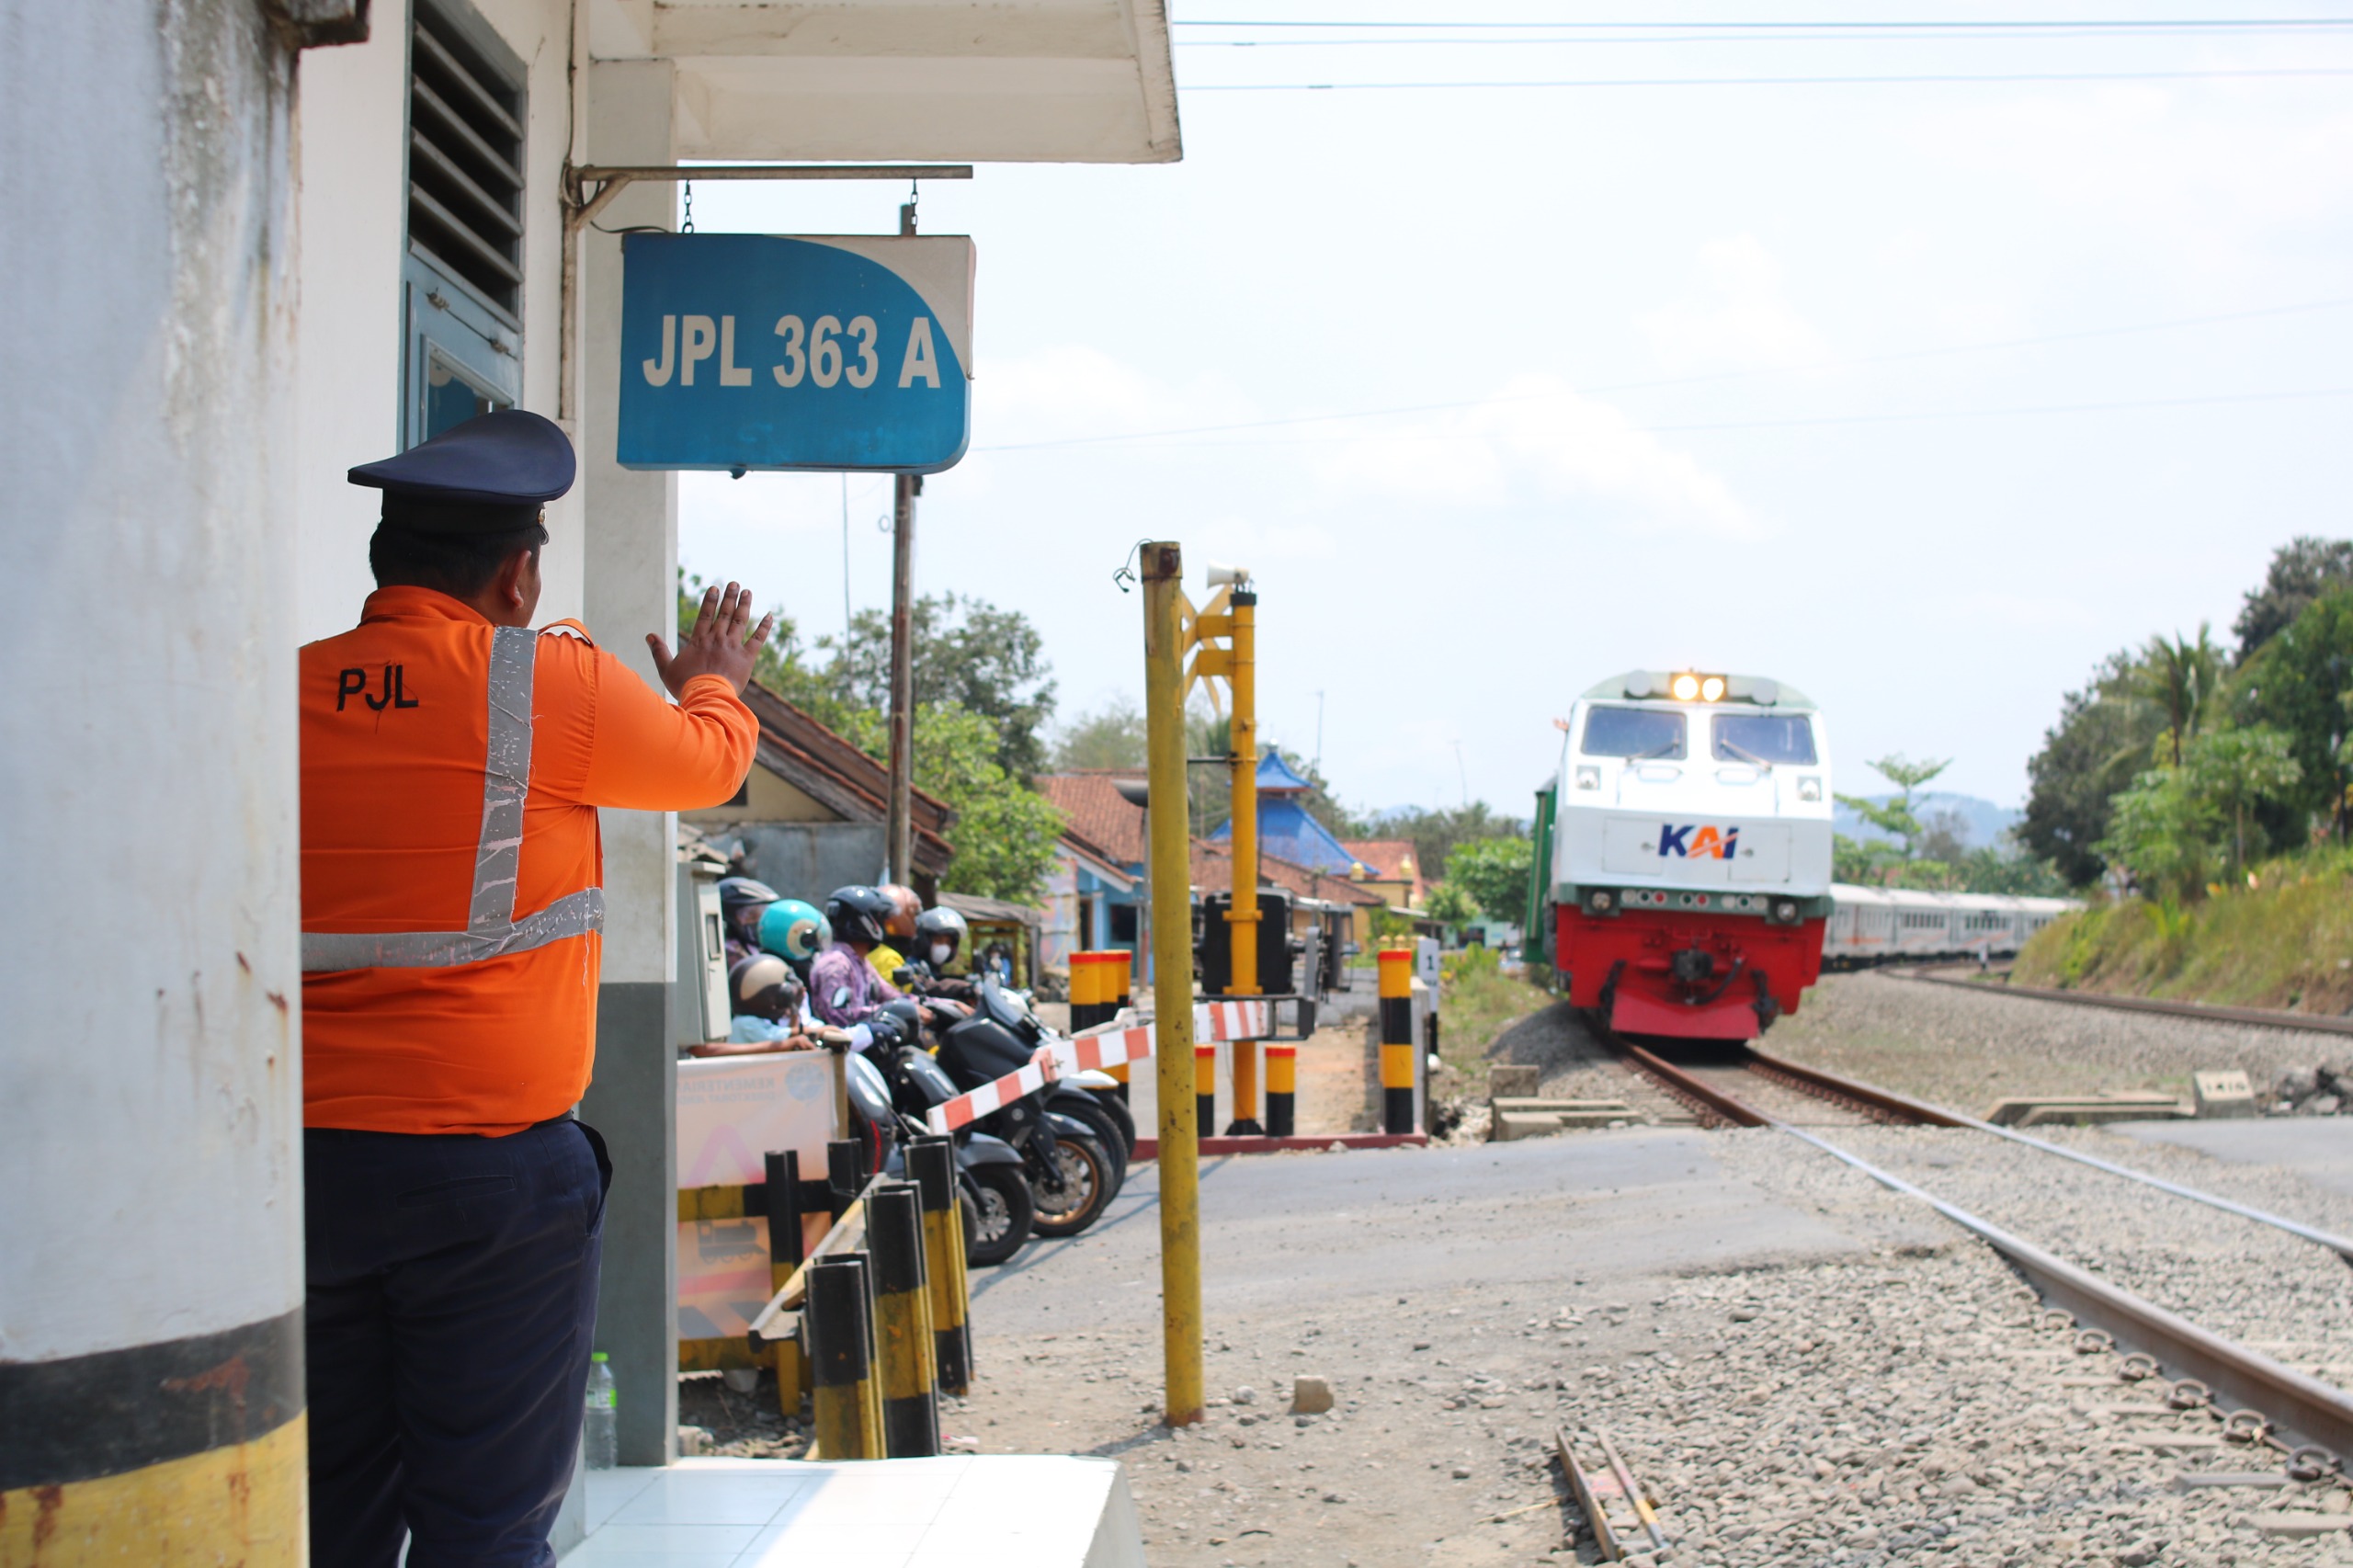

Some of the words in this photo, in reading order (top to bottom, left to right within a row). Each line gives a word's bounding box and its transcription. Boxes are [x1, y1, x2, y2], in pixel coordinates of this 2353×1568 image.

[642, 314, 752, 387] JPL
[772, 314, 879, 389] 363
[898, 316, 941, 389] A
[336, 665, 419, 711] PJL
[1658, 824, 1740, 860] KAI
